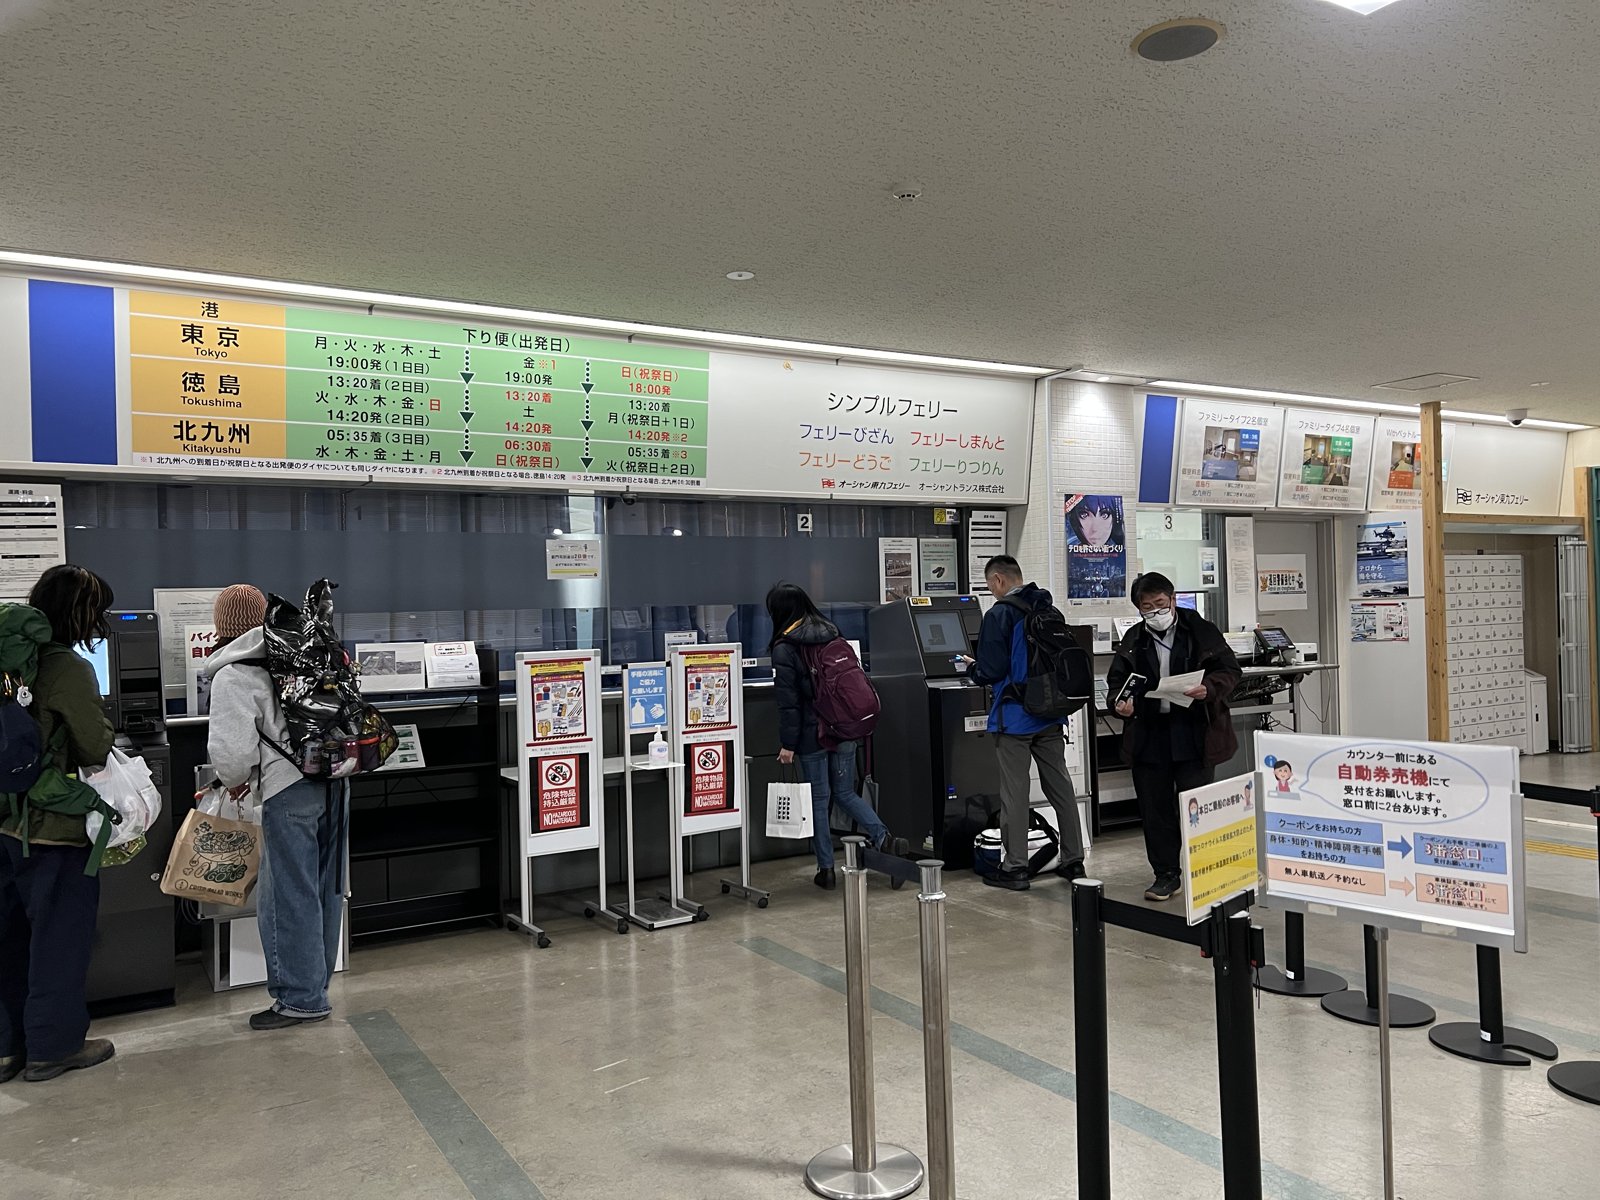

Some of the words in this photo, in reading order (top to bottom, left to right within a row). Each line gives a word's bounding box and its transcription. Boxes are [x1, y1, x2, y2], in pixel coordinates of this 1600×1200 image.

[201, 301, 219, 319] 港
[181, 323, 240, 348] 東京
[194, 347, 228, 359] Tokyo
[315, 336, 441, 359] 月・火・水・木・土
[523, 357, 535, 369] 金
[505, 371, 553, 386] 19:00発
[621, 366, 679, 382] 日（祝祭日）
[181, 371, 240, 396] 徳島
[629, 383, 671, 396] 18:00発
[180, 396, 242, 408] Tokushima
[505, 391, 552, 404] 13:20着
[523, 405, 535, 418] 土
[629, 400, 671, 412] 13:20着
[828, 392, 958, 419] シンプルフェリー
[173, 420, 250, 445] 北九州
[505, 422, 552, 435] 14:20発
[628, 430, 671, 441] 14:20発
[800, 424, 895, 445] フェリーびざん
[182, 443, 241, 454] Kitakyushu
[505, 440, 552, 452] 06:30着
[910, 431, 1005, 451] フェリーしまんと
[628, 447, 670, 459] 05:35着
[496, 454, 560, 469] 日（祝祭日）
[799, 452, 892, 471] フェリーどうご
[909, 458, 1004, 476] フェリーりつりん
[838, 480, 911, 490] オーシャン東九フェリー
[918, 482, 1005, 494] オーシャントランス株式会社
[800, 516, 809, 529] 2
[1165, 515, 1173, 530] 3
[1346, 750, 1437, 765] カウンター前にある
[1337, 763, 1450, 788] 自動券売機にて
[543, 789, 577, 800] 危険物品
[1343, 786, 1442, 804] 受付をお願いします。
[543, 797, 576, 808] 持込厳禁
[1343, 799, 1448, 819] 窓口前に2台あります。
[543, 812, 553, 826] NO
[1278, 818, 1362, 836] クーポンをお持ちの方
[1300, 850, 1346, 864] をお持ちの方
[1284, 867, 1366, 887] 無人車航送／予約なし
